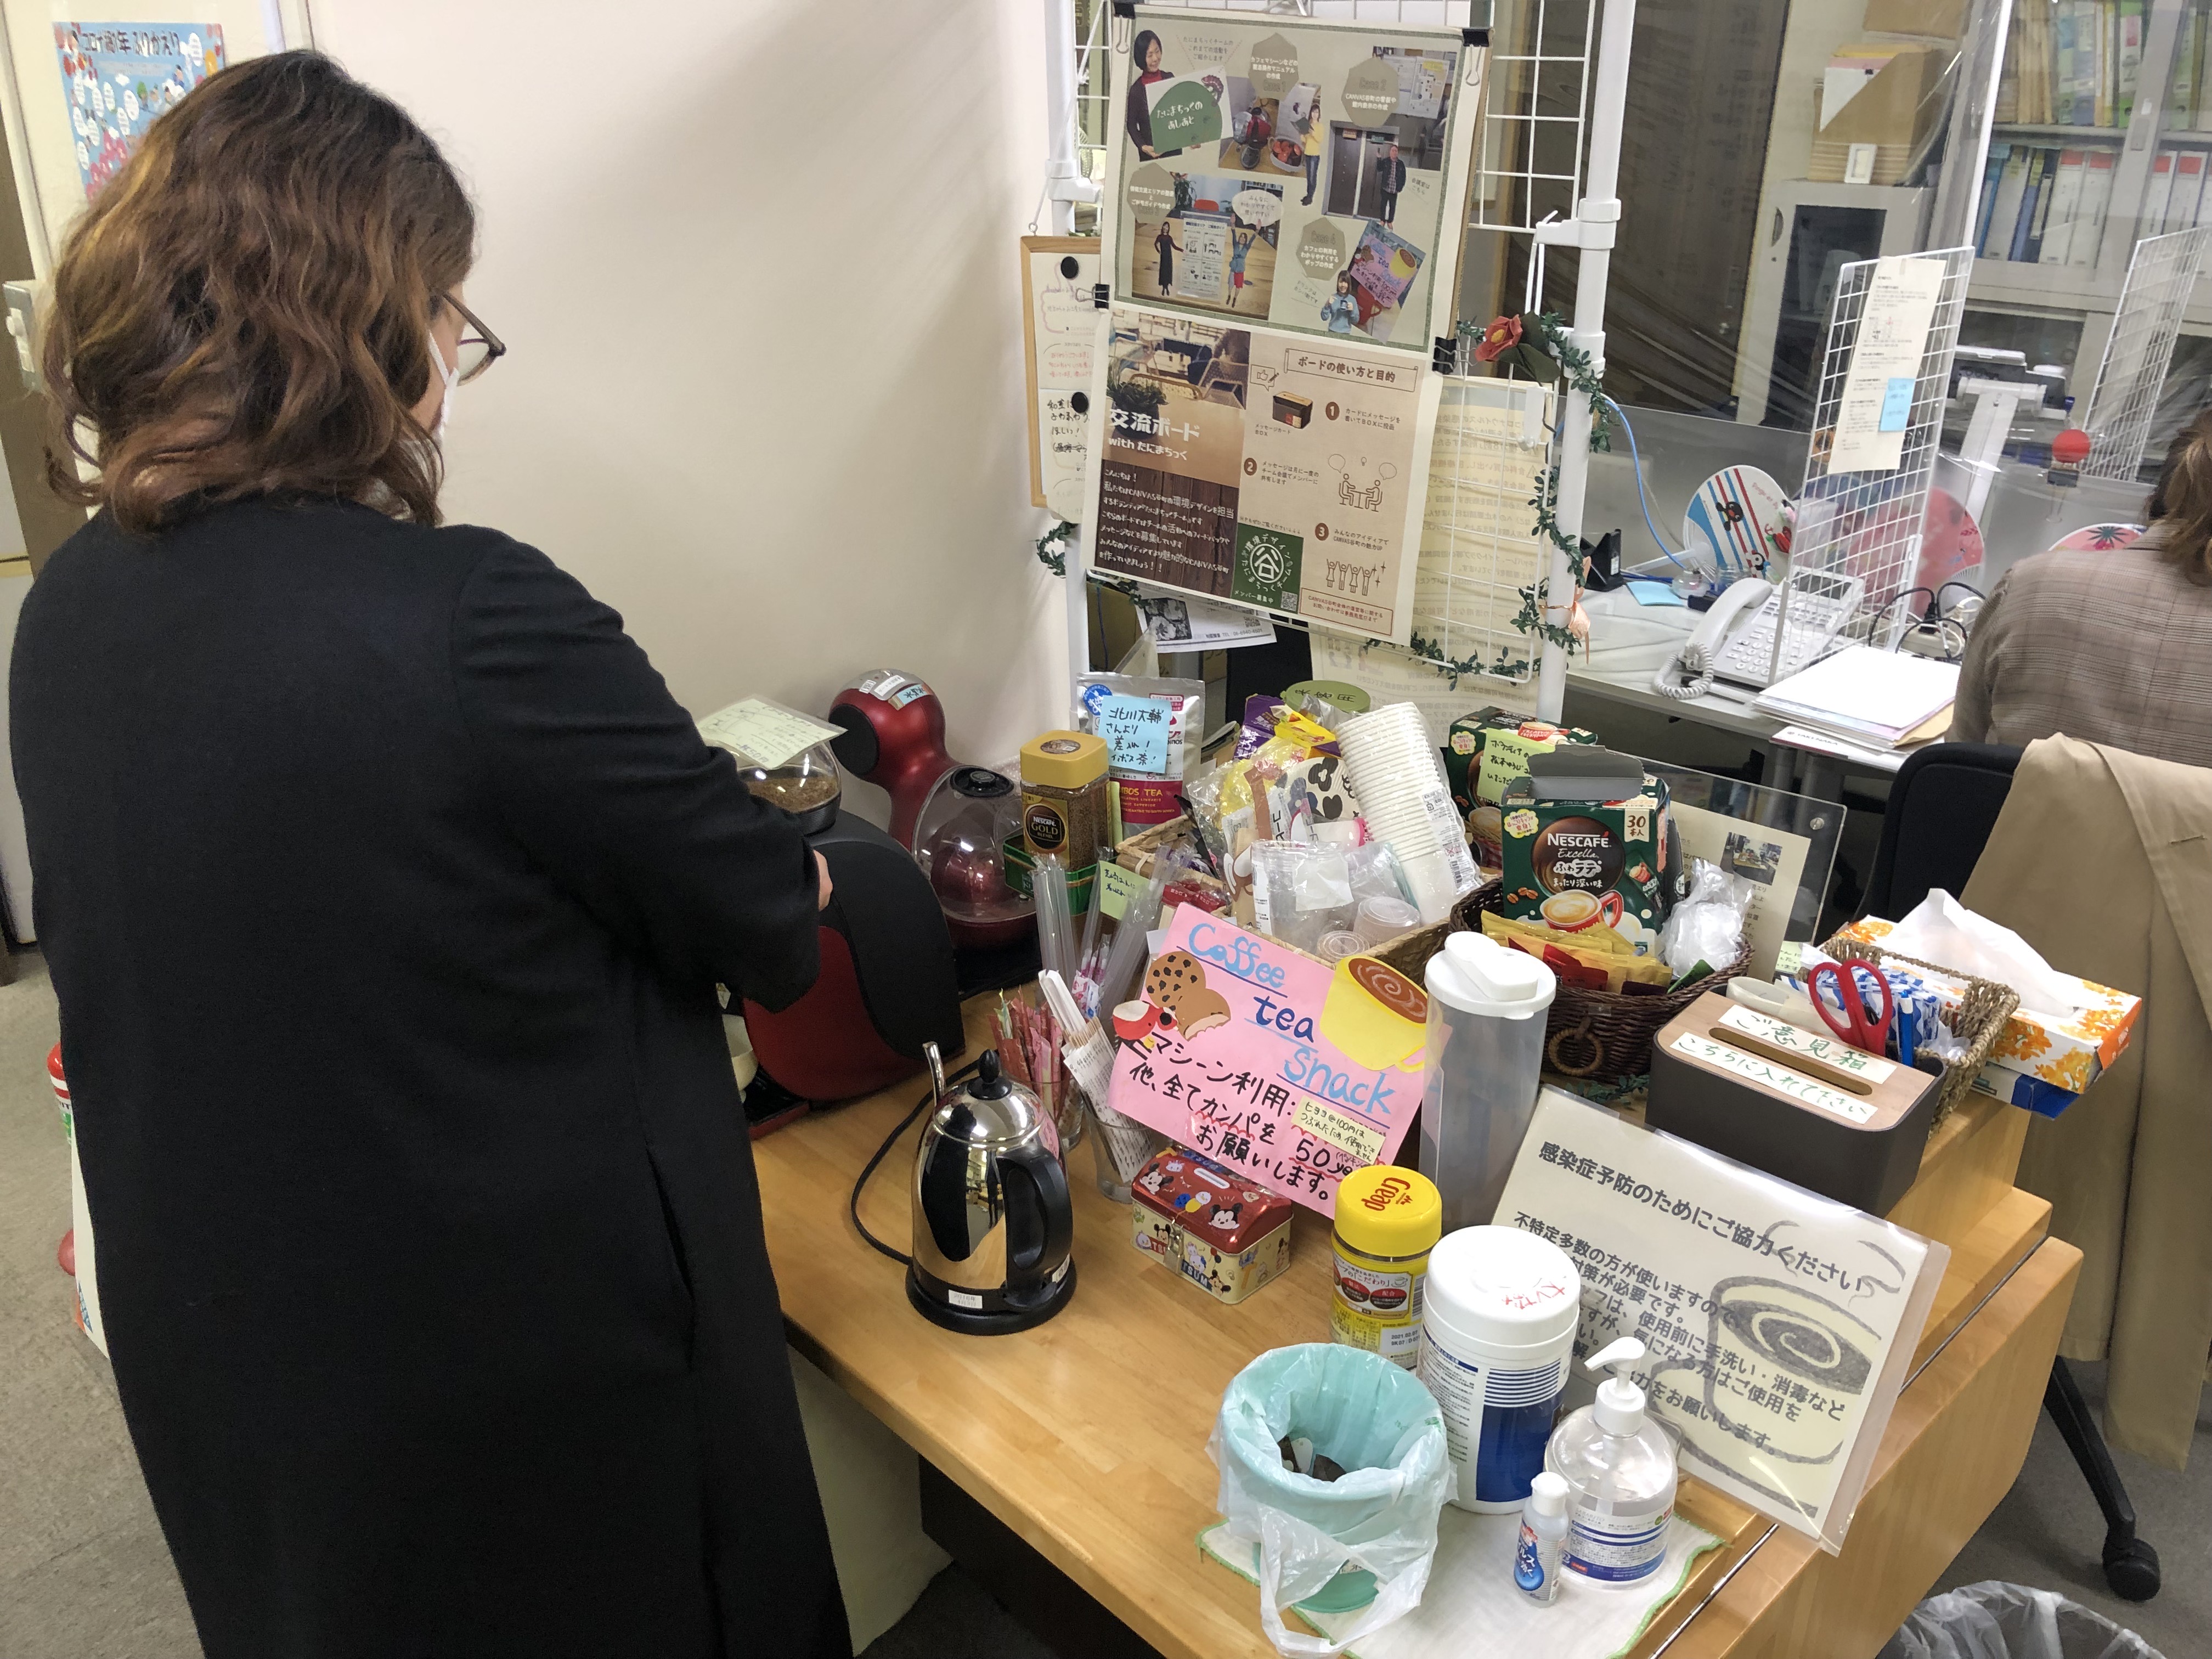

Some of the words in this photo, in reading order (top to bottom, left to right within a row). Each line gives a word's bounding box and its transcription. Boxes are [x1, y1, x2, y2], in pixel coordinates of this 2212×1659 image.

[1251, 56, 1298, 66] カフェマシーンなどの
[1156, 101, 1203, 118] たにまちっくの
[1168, 116, 1194, 130] あしあと
[1298, 357, 1396, 383] ボードの使い方と目的
[1345, 408, 1401, 424] カードにメッセージを
[1108, 408, 1200, 442] 交流ボード
[1255, 423, 1291, 435] メッセージカード
[1108, 437, 1135, 450] with
[1137, 441, 1188, 461] たにまちっく
[1261, 467, 1318, 485] チーム会議でメンバーに
[1262, 461, 1319, 478] メッセージは月に一度の
[1261, 475, 1288, 486] 共有します
[1334, 528, 1390, 545] みんなのアイディアで
[1105, 723, 1139, 735] さんより
[1144, 788, 1164, 797] TEA
[1030, 822, 1059, 836] GOLD
[1627, 815, 1646, 828] 30
[1547, 831, 1610, 848] NESCAFÉ
[1557, 848, 1599, 859] Excella
[1554, 860, 1600, 877] ふわラテ
[1553, 878, 1604, 889] まったり深い味
[1188, 922, 1286, 989] Coffee
[1253, 995, 1314, 1043] tea
[1736, 1014, 1867, 1071] ご意見箱
[1678, 1037, 1867, 1115] こちらに入れて下さい
[1129, 1059, 1277, 1147] 他、全てカンパを
[1195, 1123, 1329, 1201] お願いします。
[1361, 1177, 1412, 1212] Creap
[1538, 1141, 1863, 1293] 感染症予防のためにご協力ください
[1183, 1260, 1208, 1286] TSUM
[1514, 1211, 1736, 1327] 不特定多数の方が使いますので
